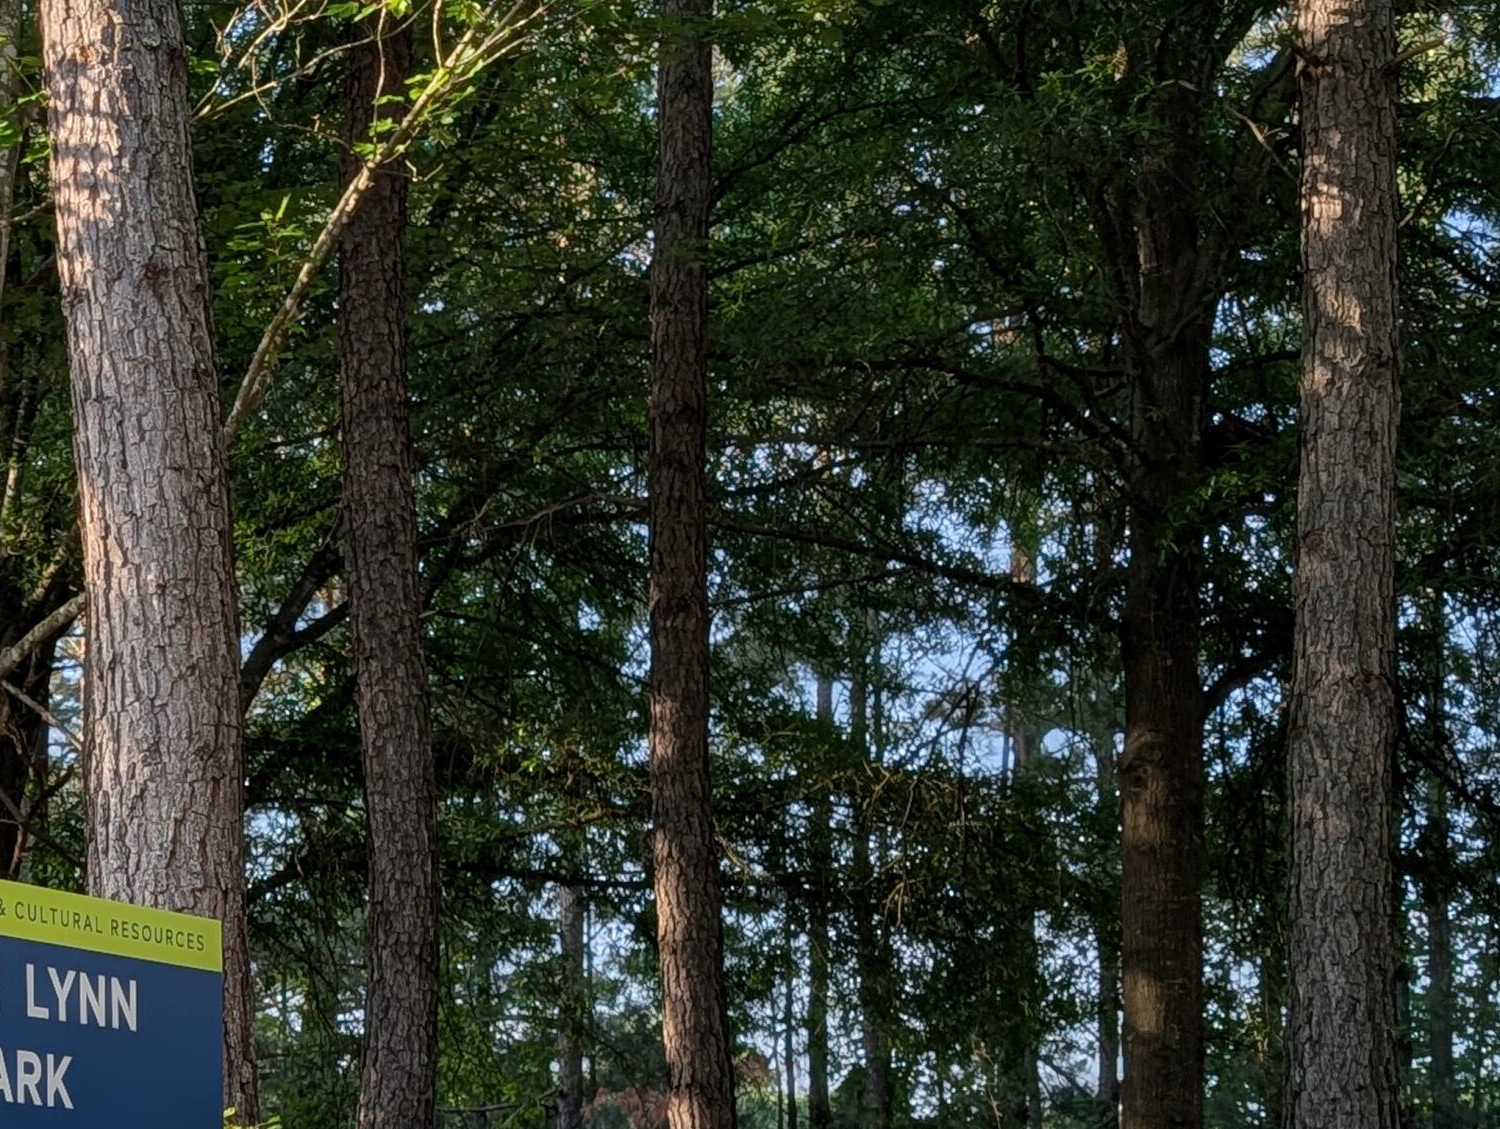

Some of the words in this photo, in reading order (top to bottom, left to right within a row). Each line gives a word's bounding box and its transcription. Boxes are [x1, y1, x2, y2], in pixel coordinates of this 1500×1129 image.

[14, 901, 103, 934] CULTURAL
[110, 919, 205, 952] RESOURCES
[25, 962, 138, 1032] LYNN
